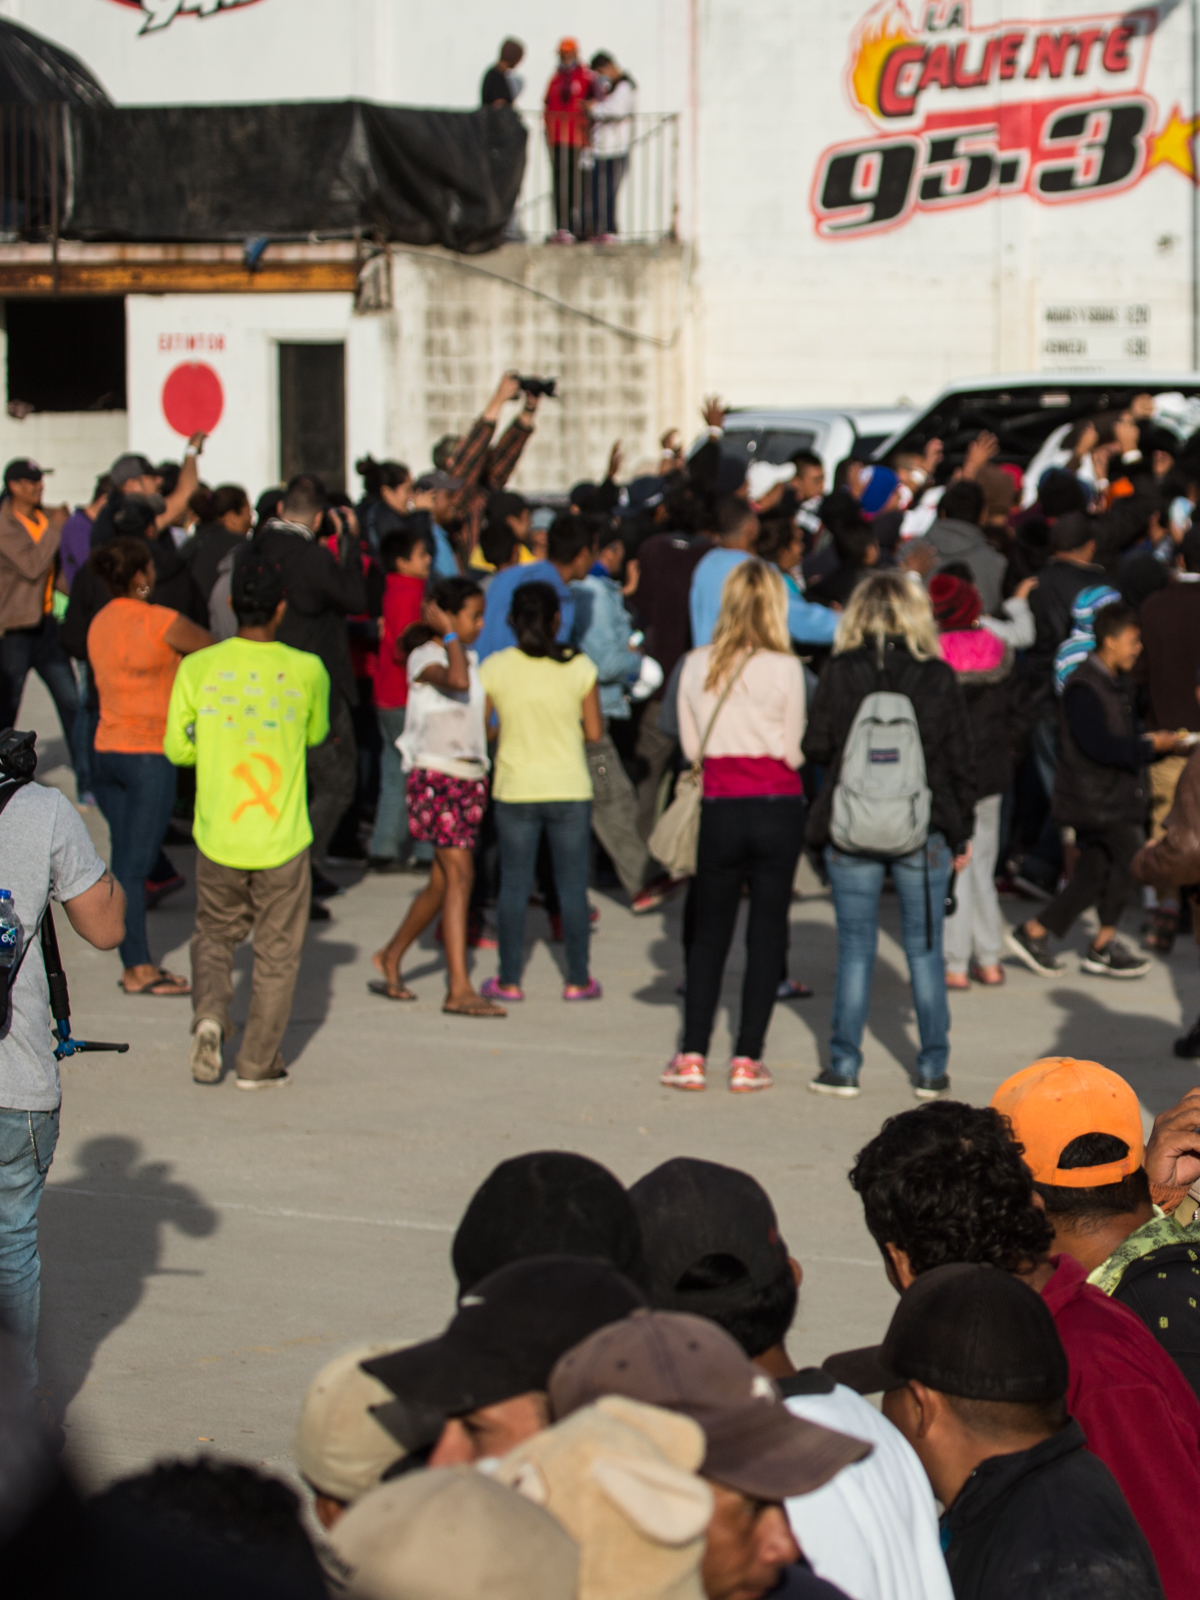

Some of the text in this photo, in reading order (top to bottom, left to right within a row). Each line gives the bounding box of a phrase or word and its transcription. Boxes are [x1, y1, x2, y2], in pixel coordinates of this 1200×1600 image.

[924, 3, 964, 32] LA
[876, 24, 1136, 119] CALIENTE
[820, 103, 1148, 232] 95.3
